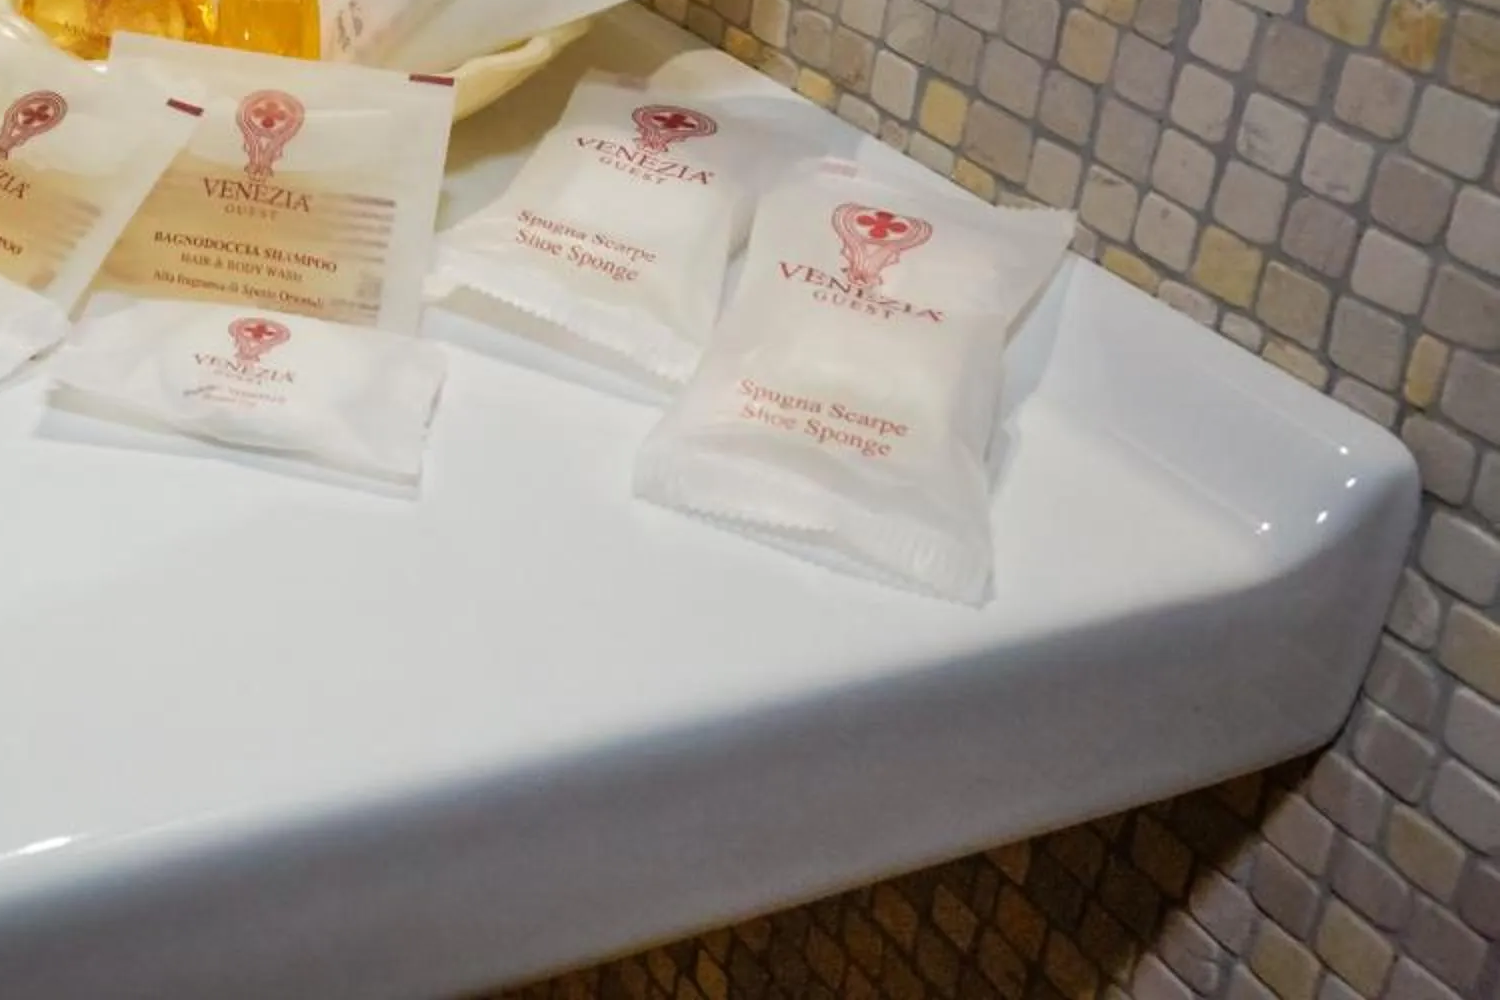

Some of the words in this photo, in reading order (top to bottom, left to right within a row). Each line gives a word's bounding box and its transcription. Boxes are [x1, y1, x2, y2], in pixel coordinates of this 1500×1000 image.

[577, 137, 714, 184] VENEZIA
[202, 177, 312, 212] VENEZIA
[154, 231, 260, 257] BAGNODOCCIA
[264, 247, 337, 273] SHAMPOO
[516, 229, 563, 256] Shoe
[567, 244, 639, 281] Sponge
[518, 210, 587, 240] Spugna
[591, 232, 657, 262] Scarpe
[779, 260, 943, 322] VENEZIA
[813, 290, 895, 320] GUEST
[194, 353, 294, 384] VENEZIA
[739, 378, 822, 413] Spugna
[828, 402, 908, 437] Scarpe
[741, 403, 797, 431] Shoe
[803, 418, 892, 457] Sponge
